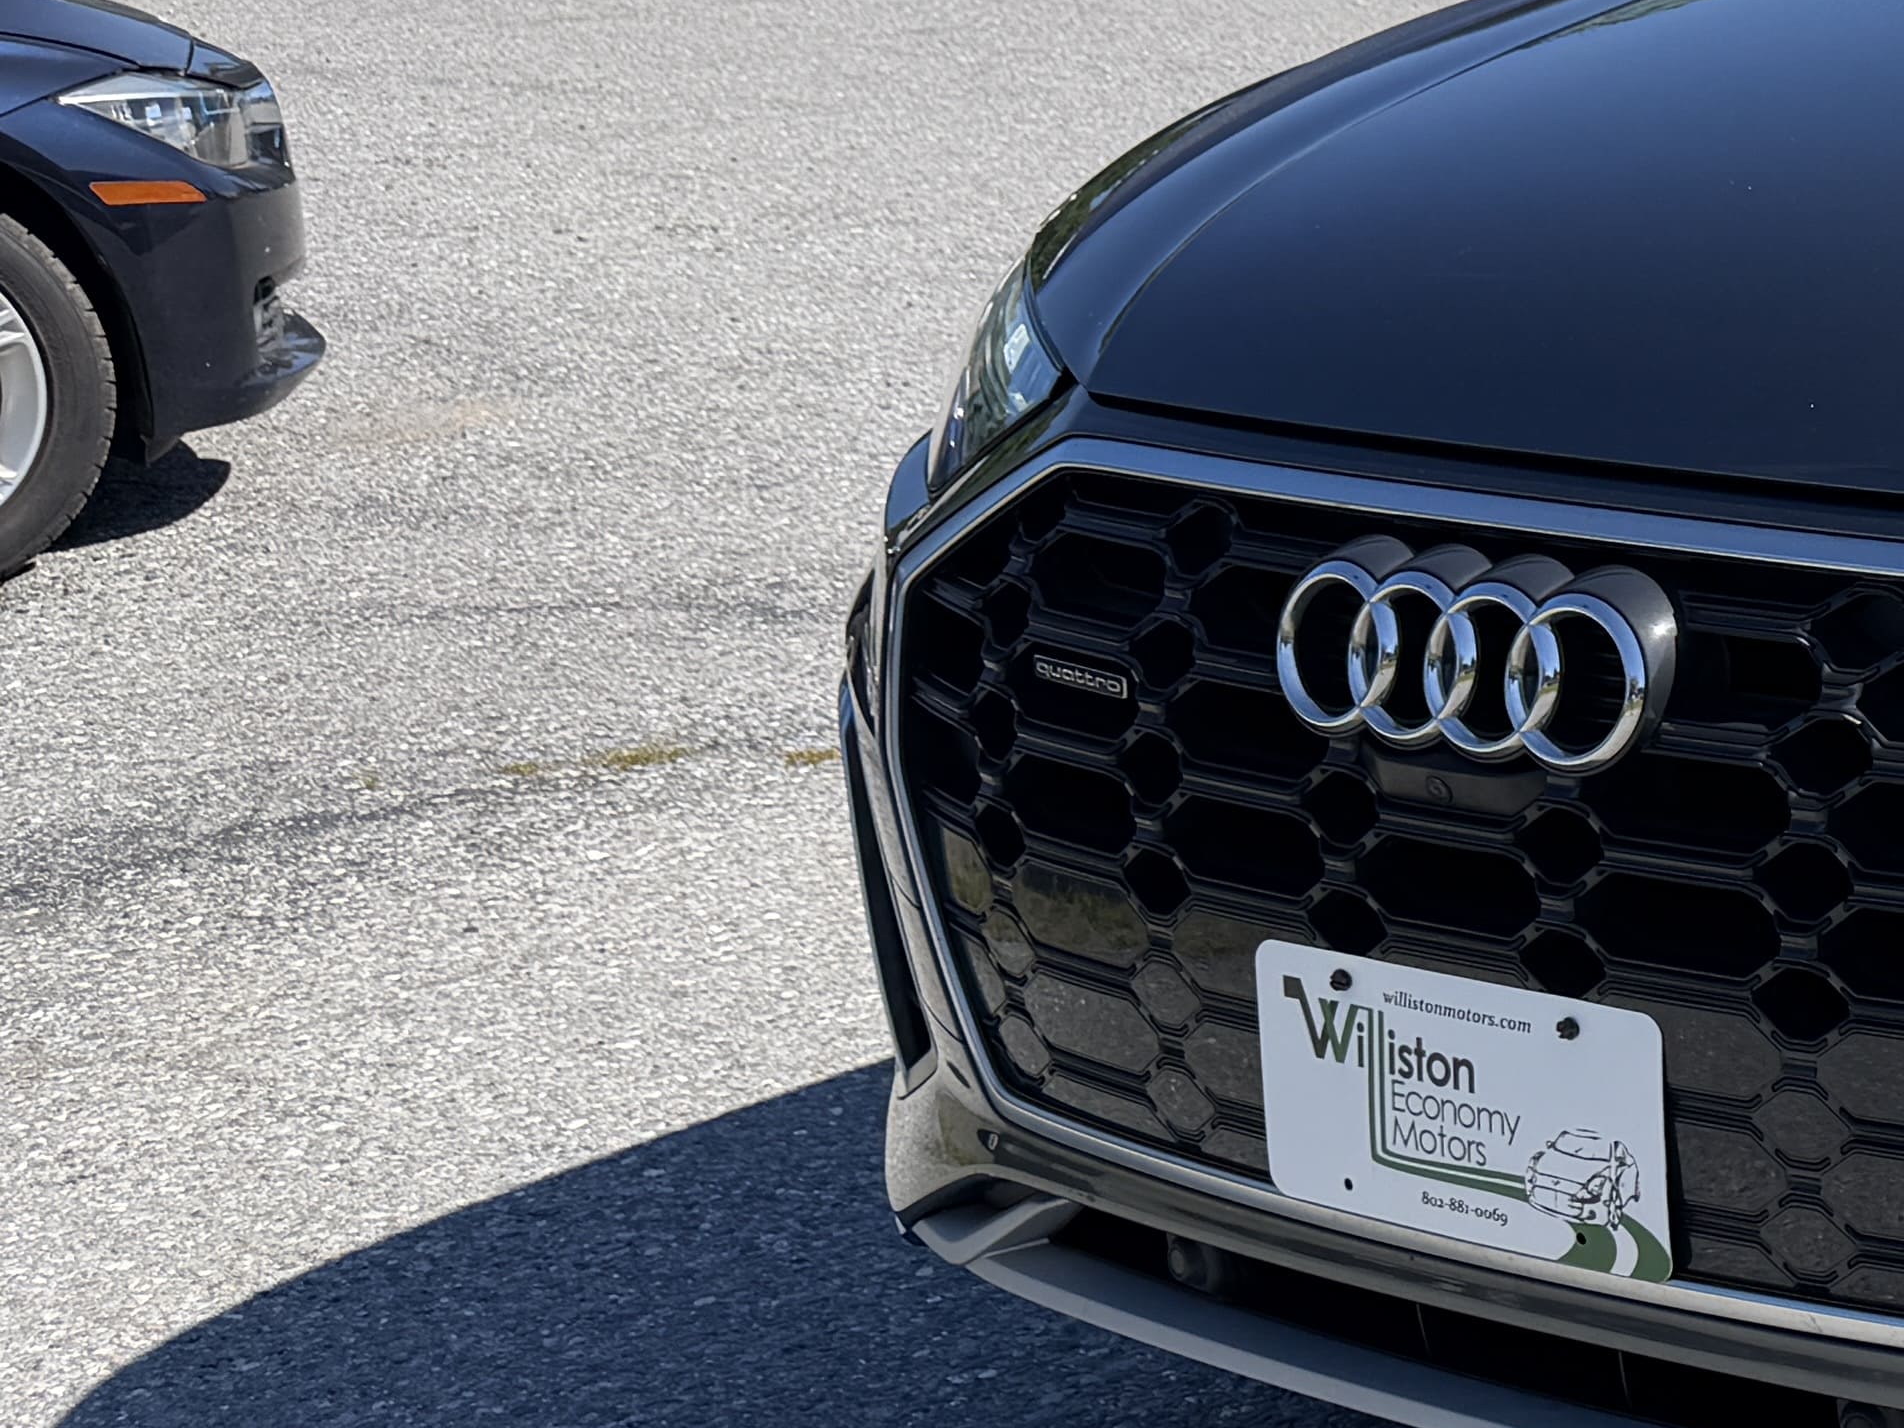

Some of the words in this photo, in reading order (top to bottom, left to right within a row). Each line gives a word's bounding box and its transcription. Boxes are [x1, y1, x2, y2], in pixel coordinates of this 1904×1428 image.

[1035, 661, 1121, 693] quattro
[1283, 974, 1476, 1094] Williston
[1382, 989, 1532, 1035] willistonmotors.com
[1391, 1079, 1521, 1147] Economy
[1391, 1117, 1487, 1167] Motors
[1421, 1190, 1509, 1227] 802-881-0069
